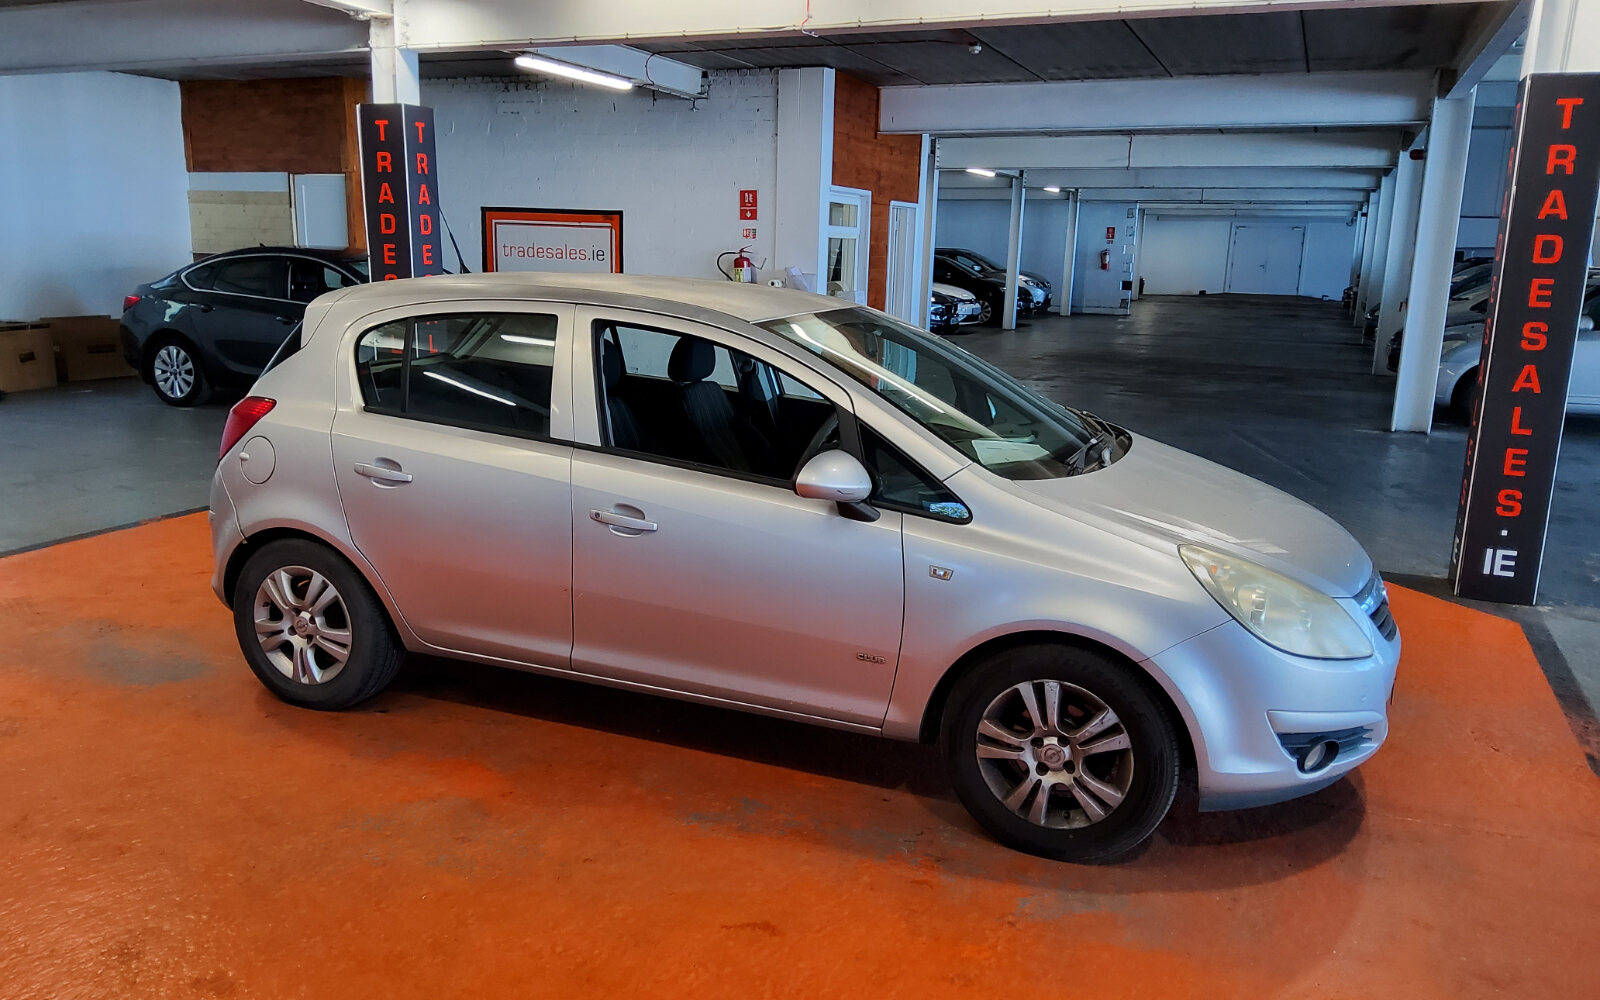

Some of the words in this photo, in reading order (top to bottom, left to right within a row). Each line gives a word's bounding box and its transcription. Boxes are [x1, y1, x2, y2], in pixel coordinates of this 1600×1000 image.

[414, 122, 433, 277] TRADE
[502, 242, 605, 262] tradesales.ie
[856, 652, 886, 664] CLUB
